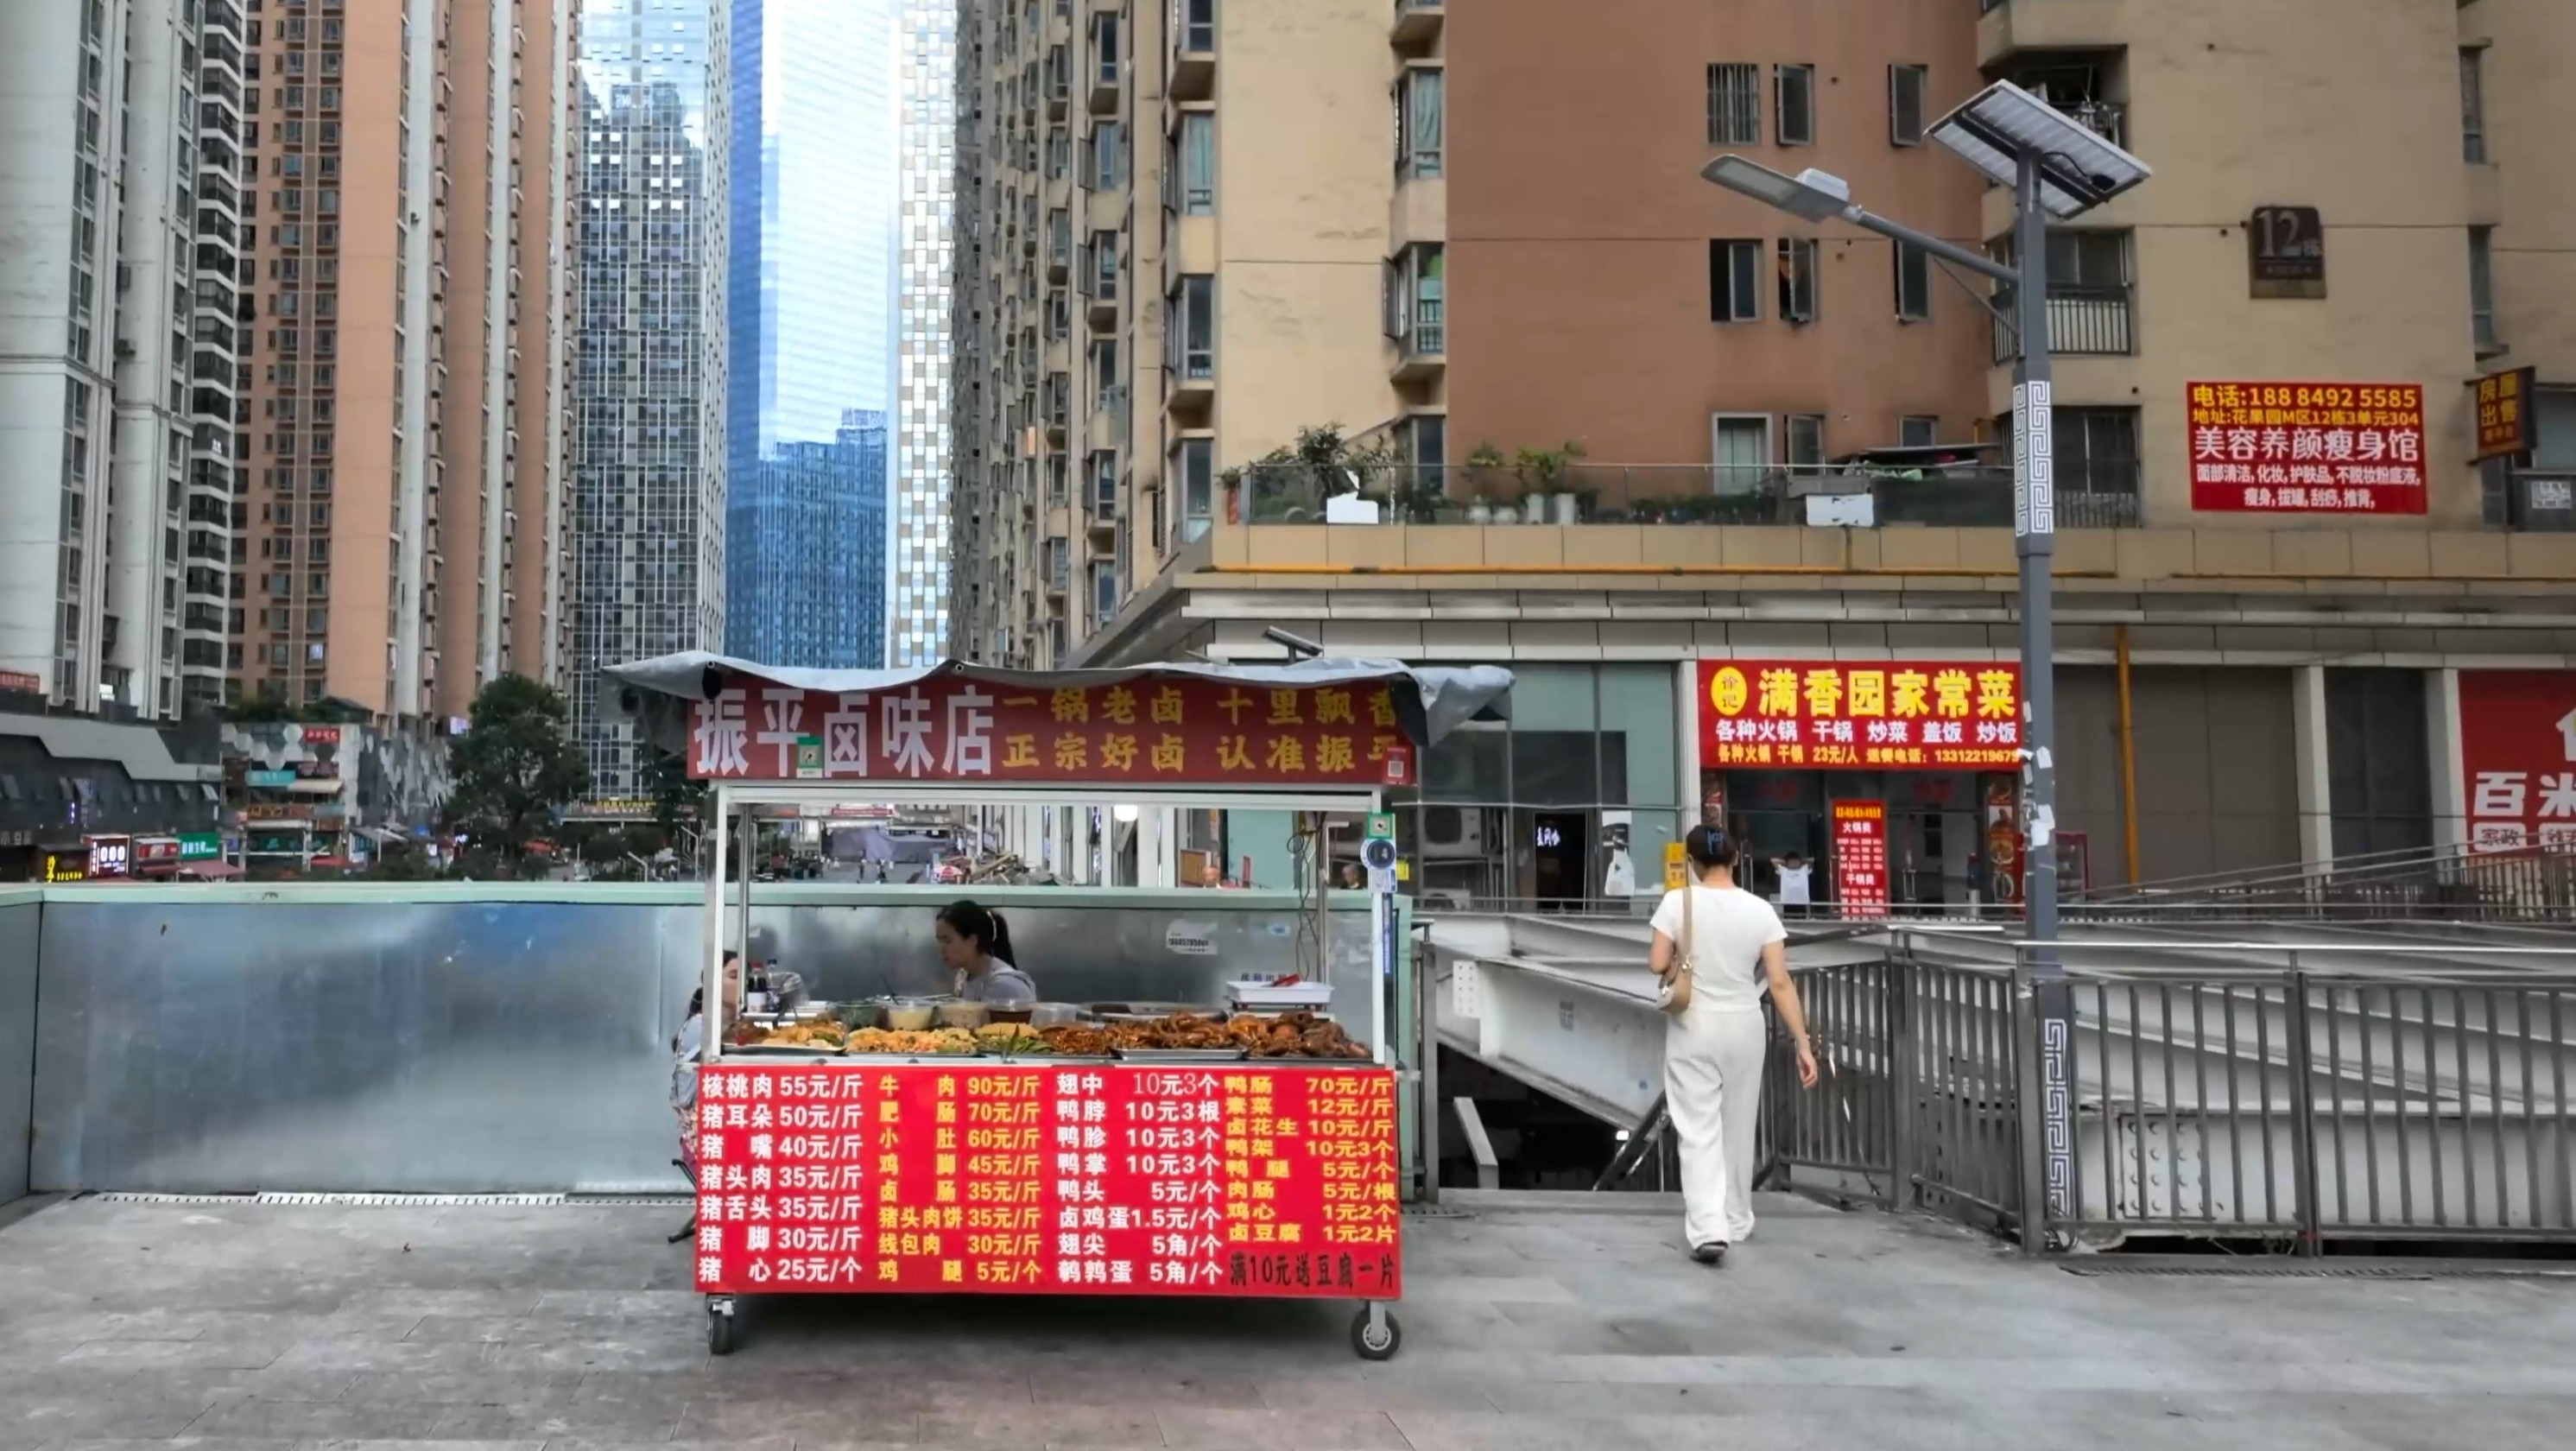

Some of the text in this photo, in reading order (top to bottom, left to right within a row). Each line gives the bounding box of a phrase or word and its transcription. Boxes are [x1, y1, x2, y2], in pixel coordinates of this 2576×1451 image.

[2297, 388, 2353, 408] 8492
[2359, 389, 2416, 408] 5585
[2195, 426, 2418, 461] 美容养颜瘦身馆
[1758, 668, 2016, 719] 满香园家常菜
[1002, 687, 1396, 726] 一锅老卤 十里飘香
[694, 685, 994, 777] 振平卤味店
[1716, 719, 2016, 745] 各种火锅 干锅 炒菜 盖饭 炒饭
[1002, 732, 1185, 773] 正宗好卤
[1718, 744, 1770, 764] 各种火锅
[1777, 745, 1804, 764] 干锅
[1813, 745, 1858, 764] 23元/人
[2473, 771, 2576, 817] 百米
[2481, 827, 2520, 846] 家政
[702, 1074, 863, 1099] 核桃肉 55元/斤
[968, 1075, 1041, 1097] 90元/斤
[1057, 1073, 1219, 1097] 翅中 10元3个
[1225, 1075, 1392, 1095] 鸭肠 70元/斤
[702, 1104, 863, 1129] 猪耳朵 50元/斤
[968, 1101, 1041, 1123] 70元/斤
[1057, 1099, 1219, 1122] 鸭脖 10元3根
[1308, 1098, 1393, 1116] 12元/斤
[968, 1128, 1041, 1149] 60元/斤
[1057, 1125, 1219, 1150] 鸭胗 10元3个
[1227, 1117, 1394, 1137] 卤花生 10元/斤
[779, 1134, 863, 1159] 40元/斤
[1225, 1138, 1394, 1158] 鸭架 10元3个
[968, 1154, 1041, 1175] 45元/斤
[1058, 1152, 1220, 1176] 鸭掌 10元3个
[1323, 1161, 1396, 1180] 5元/个
[700, 1164, 863, 1189] 猪头肉 35元/斤
[968, 1181, 1041, 1202] 35元/斤
[1058, 1179, 1221, 1203] 鸭头 5元/个
[1228, 1181, 1396, 1201] 肉肠 5元/根
[700, 1194, 863, 1220] 猪舌头 35元/斤
[879, 1206, 1041, 1229] 猪头肉饼 35元/斤
[1227, 1201, 1396, 1222] 鸡心 1元2个
[778, 1226, 862, 1251] 30元/斤
[879, 1232, 1041, 1256] 线包肉 30元/斤
[1059, 1232, 1222, 1258] 翅尖 5角/个
[1229, 1223, 1396, 1244] 卤豆腐 1元2片
[777, 1257, 862, 1282] 25元/个
[978, 1259, 1041, 1283] 5元/个
[1058, 1259, 1223, 1284] 鹌鹑蛋 5角/个
[1231, 1252, 1394, 1289] 满10元送豆腐一片
